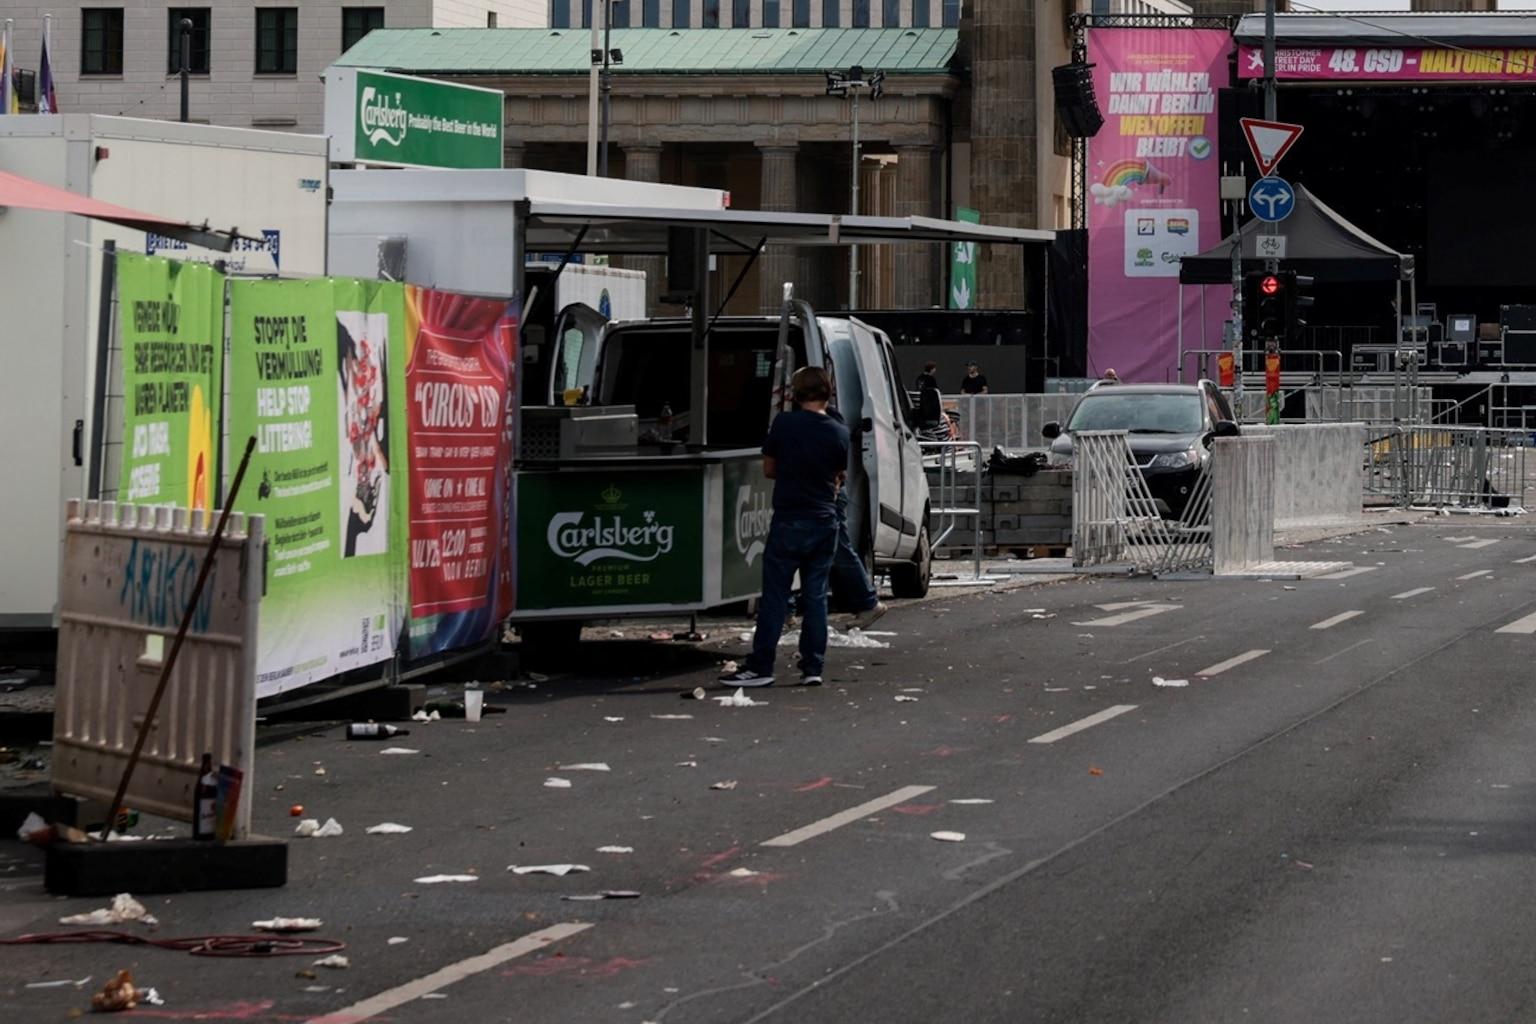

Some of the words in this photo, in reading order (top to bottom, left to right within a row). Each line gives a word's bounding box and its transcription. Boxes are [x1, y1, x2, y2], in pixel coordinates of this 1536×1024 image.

[1275, 49, 1321, 57] HRISTOPHER
[1328, 49, 1359, 72] 48.
[1363, 49, 1404, 72] CSD
[1419, 48, 1504, 73] HALTUNG
[1275, 64, 1298, 72] ERLIN
[1299, 64, 1321, 72] PRIDE
[1110, 72, 1143, 92] WIR
[1146, 68, 1212, 95] WÄHLEN,
[1108, 94, 1159, 114] DAMIT
[1161, 94, 1215, 114] BERLIN
[361, 87, 407, 146] Carlsberg
[1120, 115, 1206, 136] WELTOFFEN
[1136, 137, 1188, 157] BLEIBT
[291, 315, 308, 343] DIE
[257, 387, 285, 417] HELP
[286, 385, 310, 416] STOP
[547, 510, 674, 567] Carlsberg
[570, 575, 613, 588] LAGER
[617, 574, 651, 586] BEER
